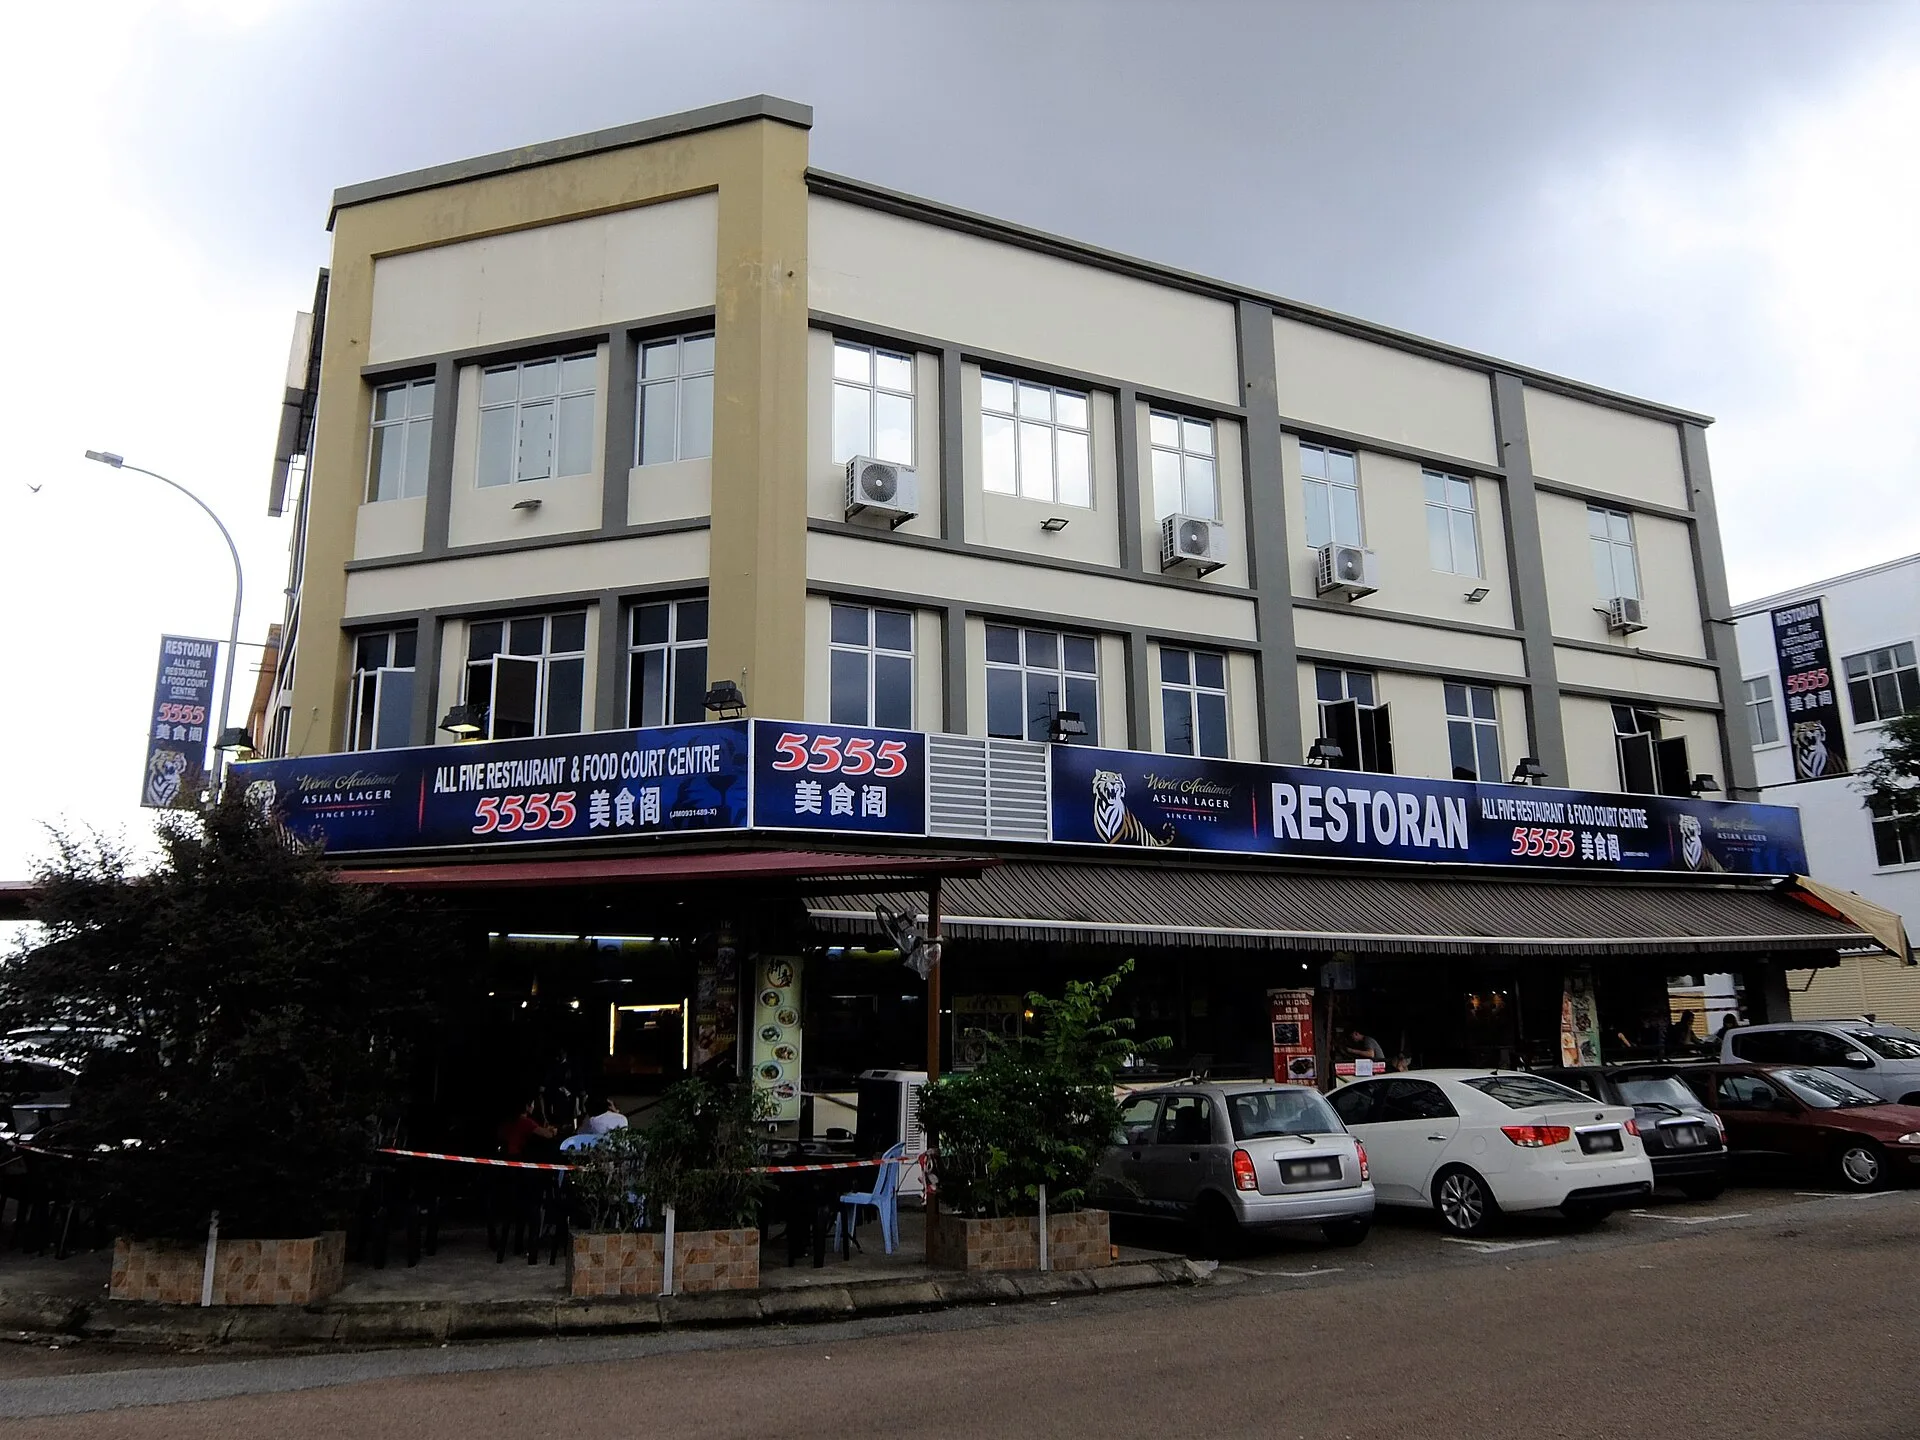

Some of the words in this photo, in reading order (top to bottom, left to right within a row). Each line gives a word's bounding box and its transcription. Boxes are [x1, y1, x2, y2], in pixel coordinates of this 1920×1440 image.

[165, 640, 212, 658] RESTORAN
[165, 666, 207, 679] RESTAURANT
[173, 658, 186, 668] ALL
[186, 659, 201, 669] FIVE
[167, 676, 186, 687] FOOD
[185, 678, 208, 688] COURT
[171, 686, 197, 697] CENTRE
[1787, 667, 1830, 695] 5555
[157, 702, 205, 725] 5555
[156, 724, 202, 741] 美食阁
[772, 732, 907, 778] 5555
[297, 773, 333, 791] World
[334, 770, 400, 790] Acclaimed
[433, 766, 458, 794] ALL
[459, 763, 485, 792] FIVE
[486, 757, 566, 790] RESTAURANT
[570, 755, 580, 783] &
[583, 752, 619, 782] FOOD
[621, 749, 666, 779] COURT
[667, 744, 720, 776] CENTRE
[1143, 773, 1180, 790] World
[1180, 777, 1235, 796] Acclaimed
[302, 793, 342, 804] ASIAN
[348, 790, 392, 801] LAGER
[589, 786, 661, 829] 美食阁
[794, 780, 887, 818] 美食阁
[1152, 794, 1188, 805] ASIAN
[1194, 797, 1230, 808] LAGER
[315, 811, 345, 819] SINCE
[472, 791, 577, 834] 5555
[1166, 812, 1192, 820] SINCE
[1271, 782, 1469, 850] RESTORAN
[1482, 798, 1498, 819] ALL
[1497, 798, 1517, 821] FIVE
[1515, 800, 1565, 823] RESTAURANT
[1566, 803, 1575, 825] &
[1573, 804, 1595, 826] FOOD
[1594, 805, 1618, 828] COURT
[1618, 807, 1648, 828] CENTRE
[1511, 826, 1576, 858] 5555
[1581, 830, 1621, 862] 美食阁
